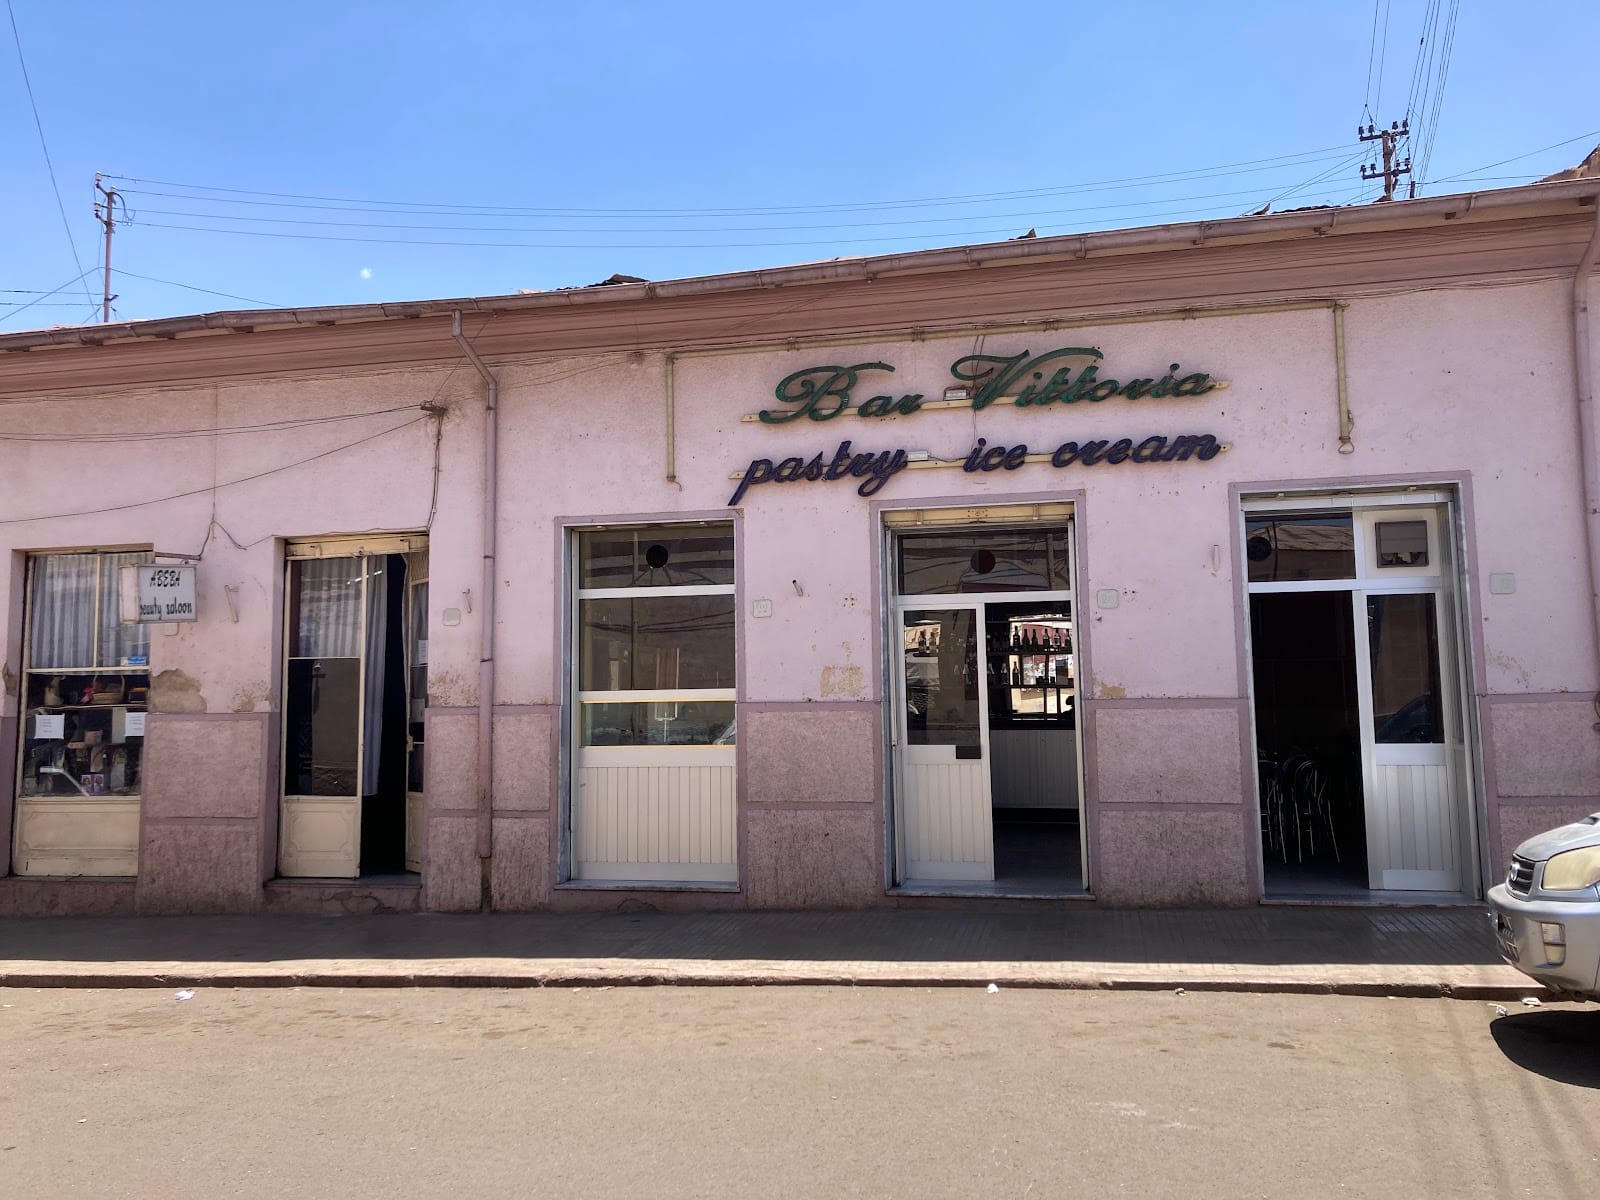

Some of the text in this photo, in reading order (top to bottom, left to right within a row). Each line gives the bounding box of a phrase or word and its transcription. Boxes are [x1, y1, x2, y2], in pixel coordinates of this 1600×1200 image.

[758, 347, 1215, 424] Bar Vittoria
[728, 430, 1221, 506] pastry ice cream
[150, 569, 181, 587] ABEBA
[166, 597, 192, 615] saloon
